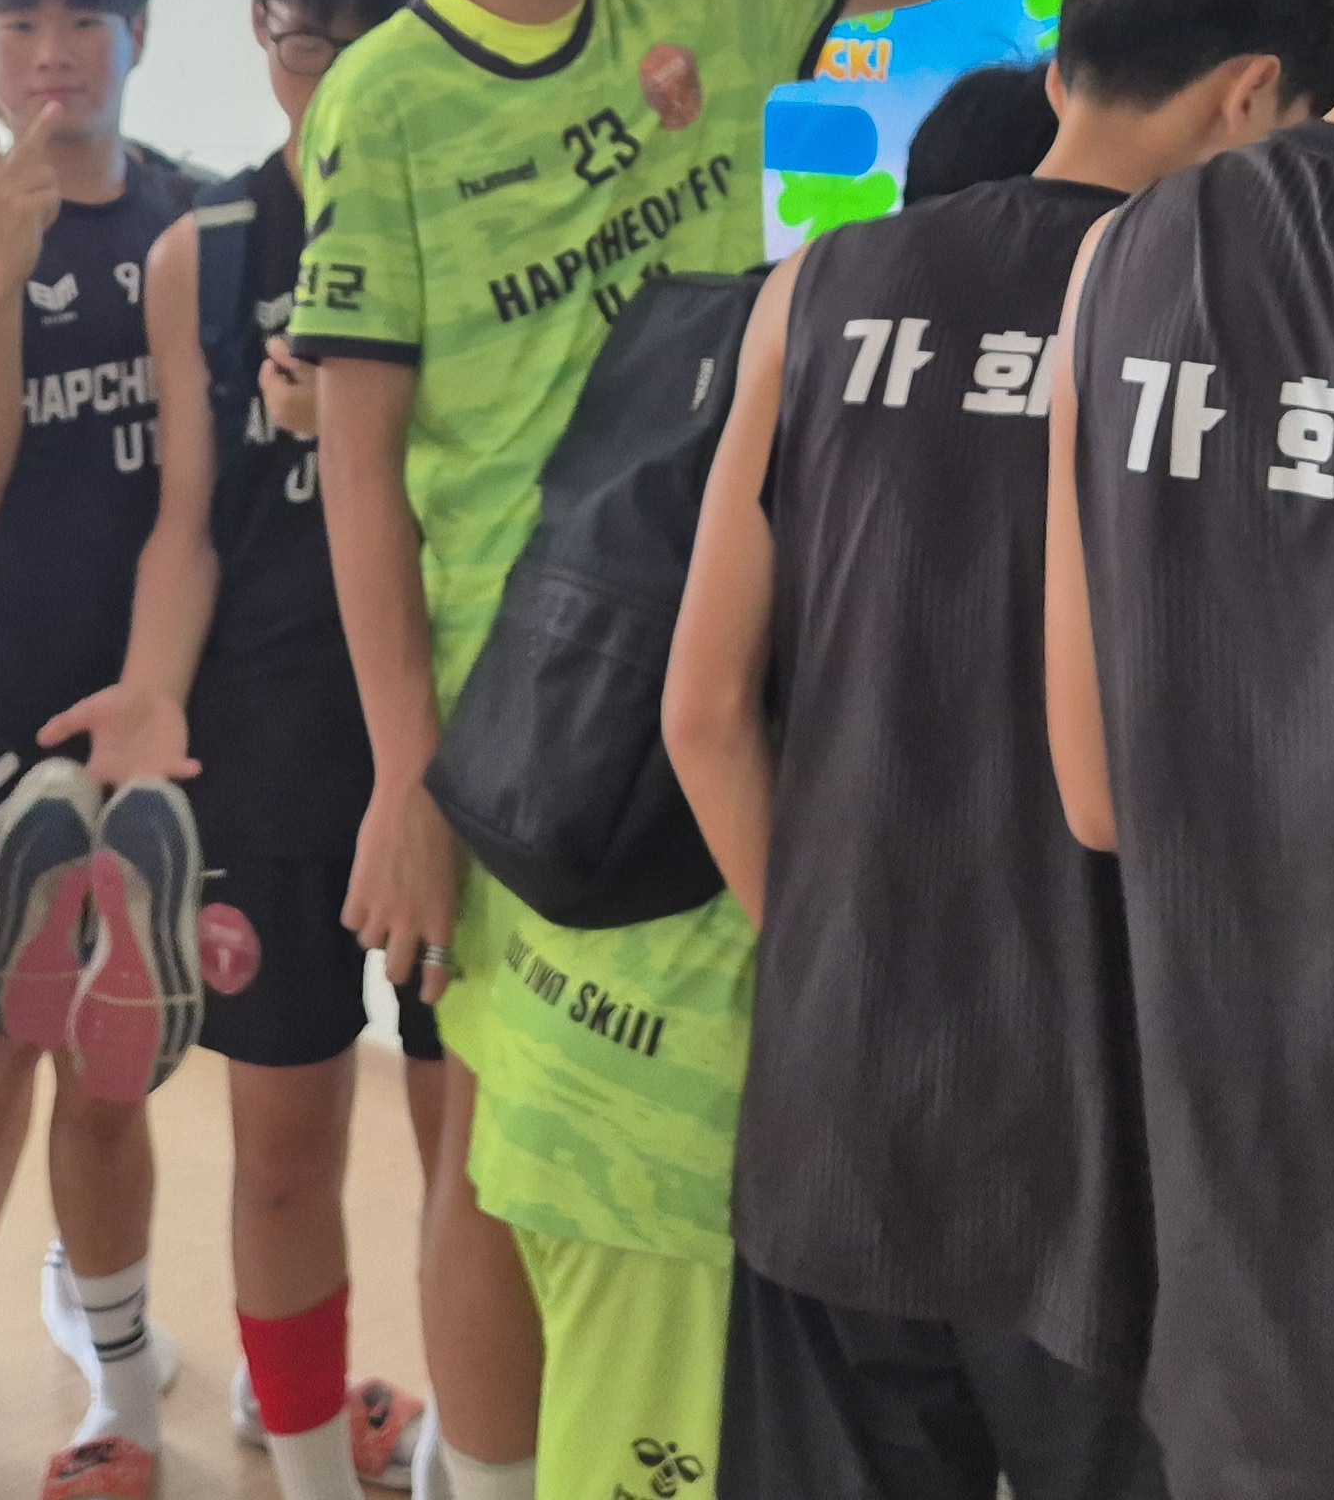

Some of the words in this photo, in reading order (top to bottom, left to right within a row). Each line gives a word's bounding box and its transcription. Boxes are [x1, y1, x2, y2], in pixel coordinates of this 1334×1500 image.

[813, 37, 894, 83] CK!
[562, 106, 642, 187] 23
[570, 980, 665, 1057] Skill
